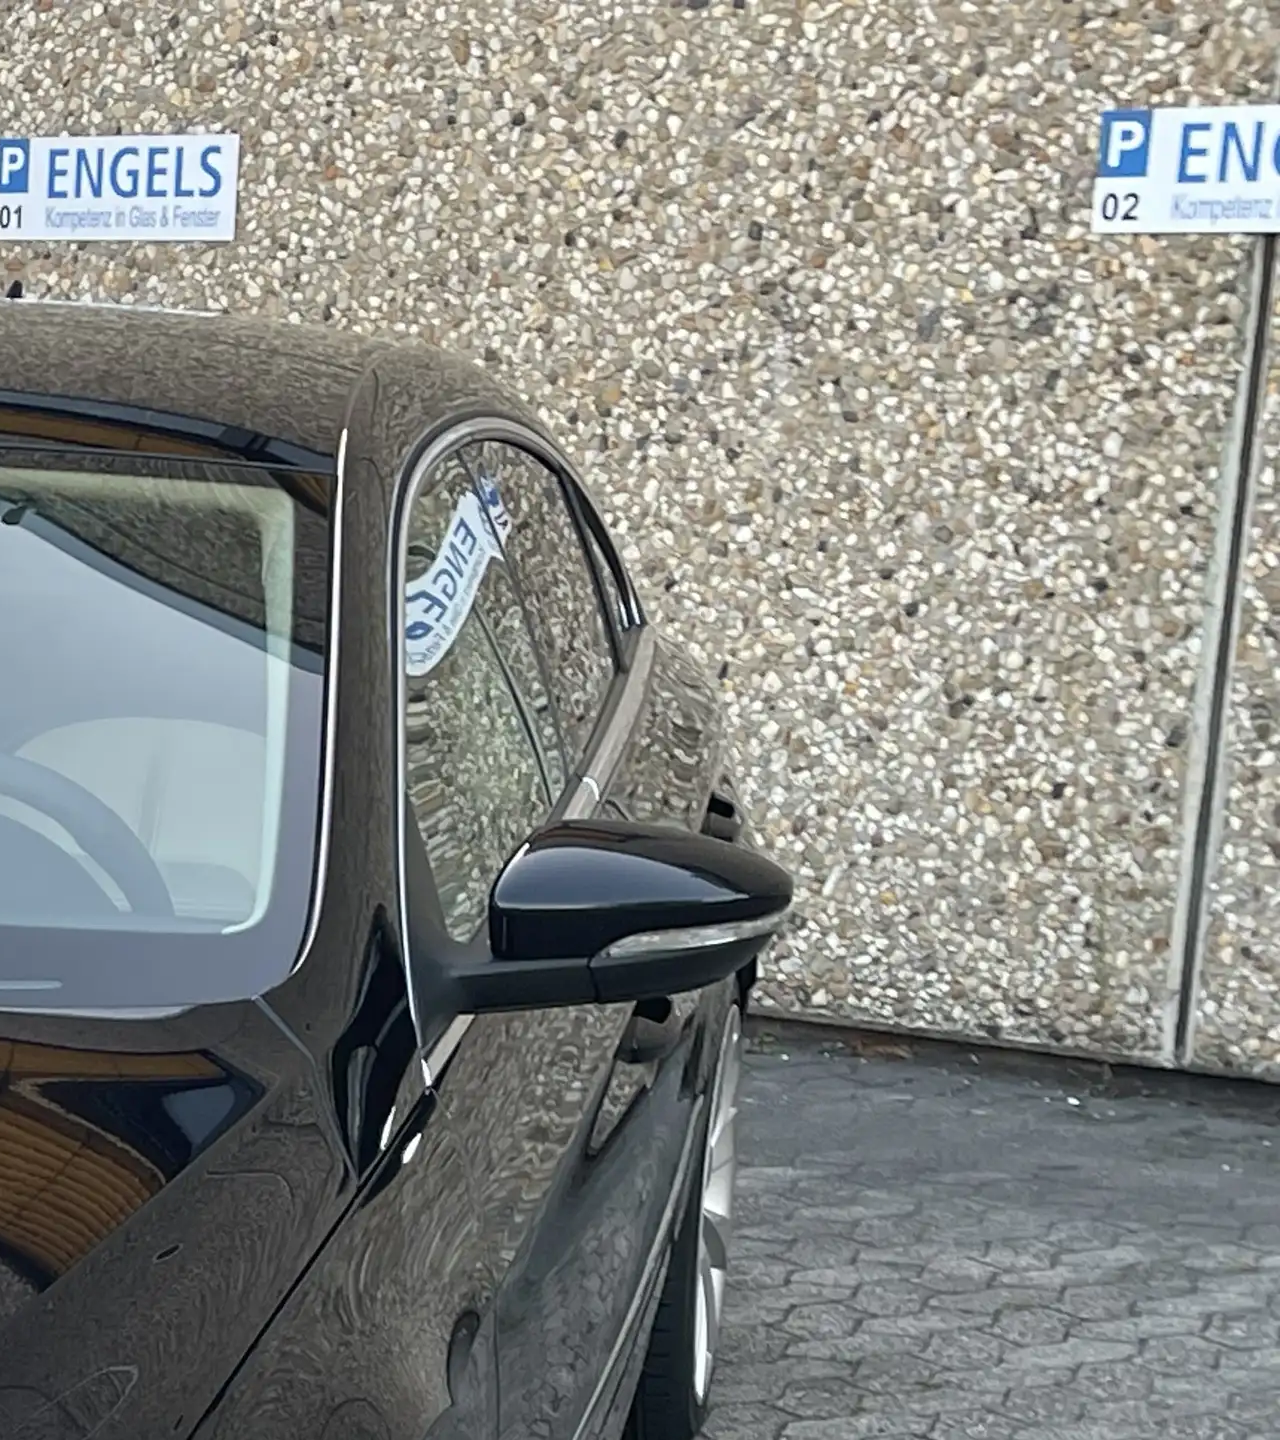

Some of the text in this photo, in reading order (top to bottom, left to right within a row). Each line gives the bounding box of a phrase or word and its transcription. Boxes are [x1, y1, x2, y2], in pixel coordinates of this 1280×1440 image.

[1178, 121, 1280, 183] EN
[48, 146, 222, 198] ENGELS
[0, 205, 22, 229] 01
[45, 206, 111, 232] Kompetenz
[115, 207, 126, 228] in
[129, 205, 156, 228] Glas
[173, 205, 221, 228] Fenster
[1102, 193, 1139, 221] 02
